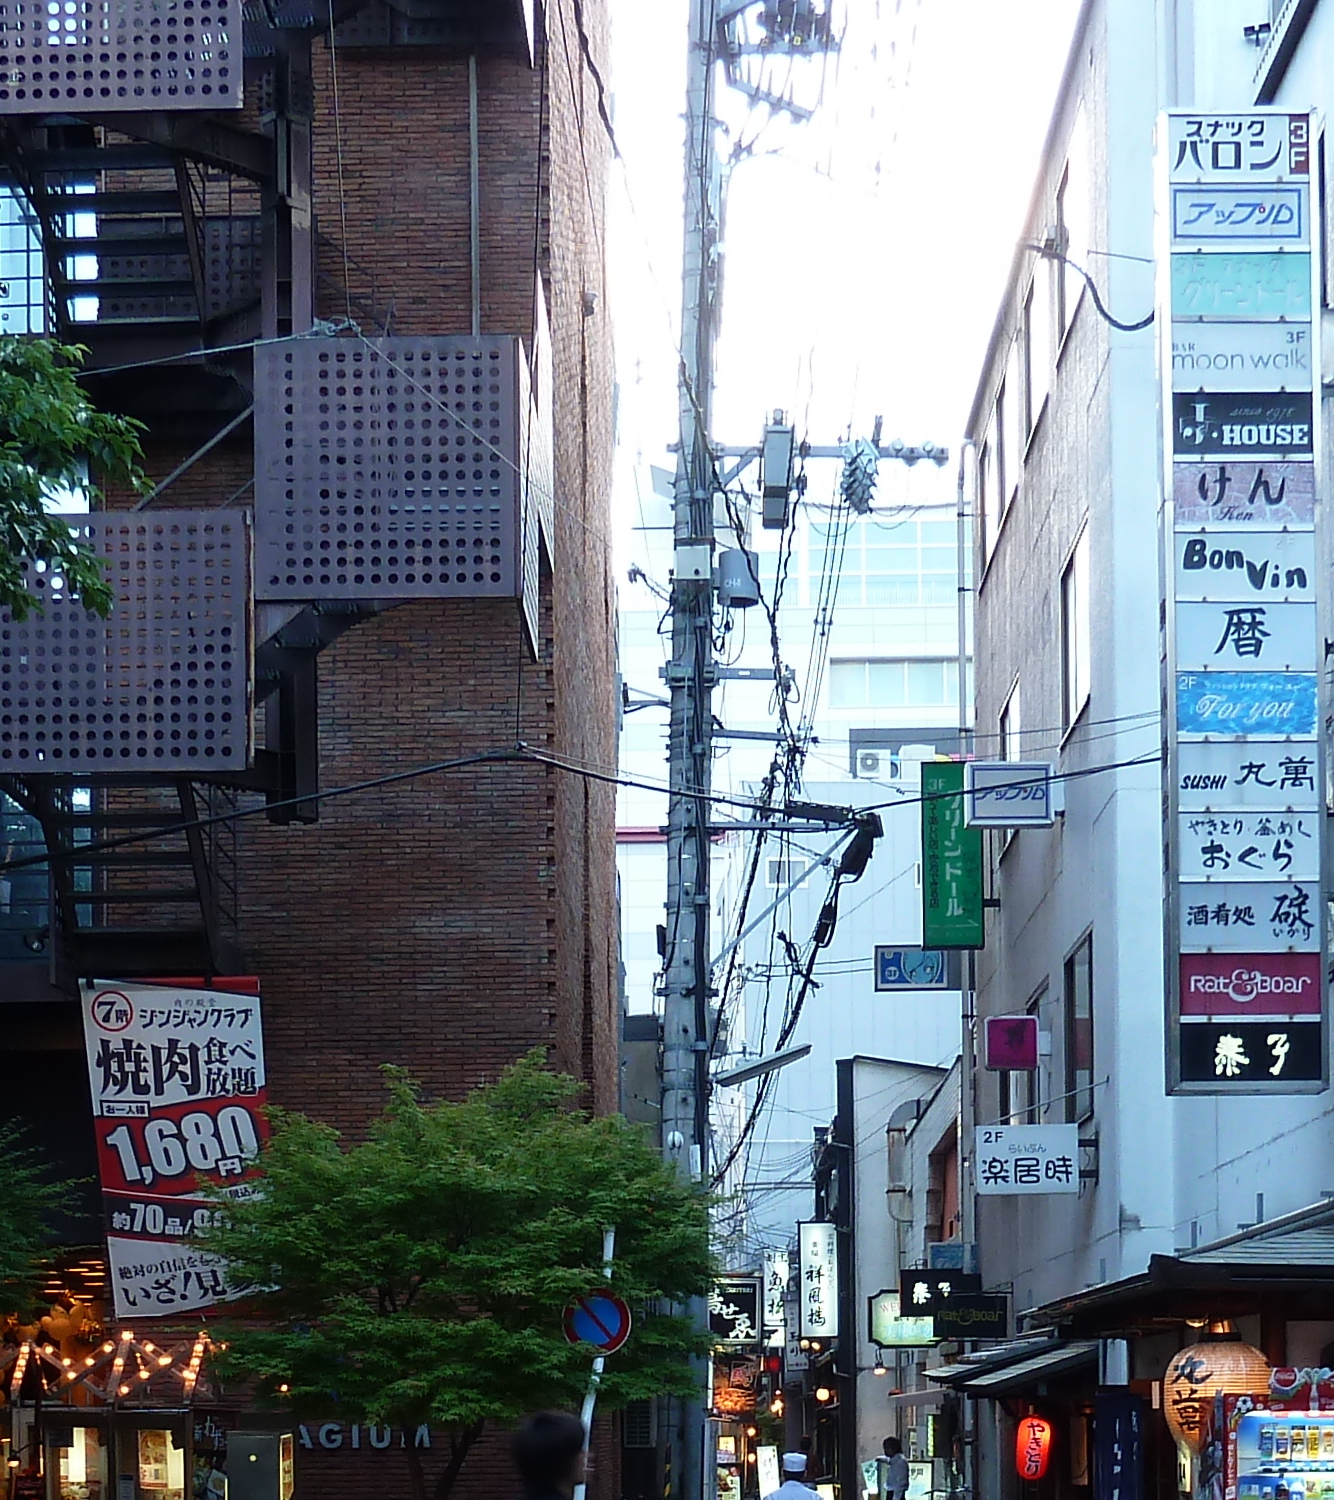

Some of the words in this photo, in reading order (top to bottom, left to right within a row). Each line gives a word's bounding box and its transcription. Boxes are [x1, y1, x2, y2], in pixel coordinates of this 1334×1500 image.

[1186, 120, 1265, 138] スナック
[1174, 139, 1281, 171] バロン
[1286, 332, 1306, 343] 3F
[1172, 354, 1243, 370] moon
[1250, 349, 1306, 369] walk
[1198, 466, 1286, 506] けん
[1183, 538, 1244, 570] Bon
[1246, 560, 1307, 590] Vin
[1214, 607, 1272, 658] 暦
[1179, 677, 1197, 689] 2F
[1244, 702, 1294, 724] you
[1180, 774, 1227, 790] SUSHI
[1235, 756, 1314, 791] 丸萬
[1201, 840, 1294, 872] おぐら
[1186, 903, 1256, 926] 酒肴処
[1273, 927, 1311, 941] いかり
[139, 1007, 253, 1030] ジンジャンクラブ
[95, 1037, 201, 1098] 焼肉
[984, 1131, 1004, 1143] 2F
[981, 1155, 1073, 1185] 楽居時
[1026, 1422, 1045, 1475] やきとり
